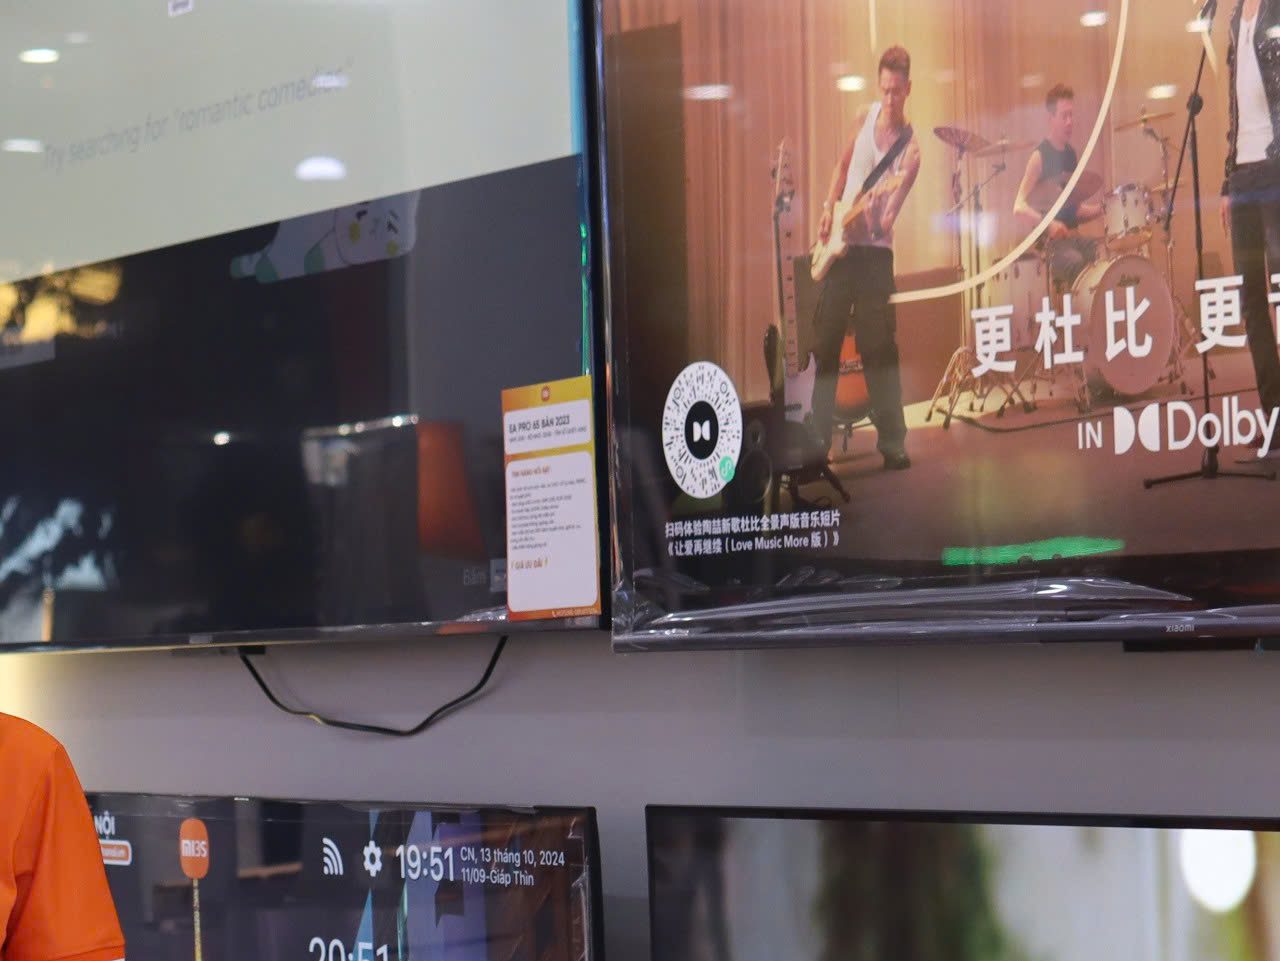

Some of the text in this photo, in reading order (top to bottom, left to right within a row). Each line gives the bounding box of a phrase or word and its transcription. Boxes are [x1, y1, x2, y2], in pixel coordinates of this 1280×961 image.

[69, 125, 141, 164] searching
[144, 112, 168, 143] for
[970, 273, 1280, 378] 更杜比 更
[1077, 395, 1280, 459] IN Dolby
[755, 536, 781, 550] Music
[784, 534, 808, 548] More
[395, 844, 565, 882] 19:51 CN, 13 tháng 10, 2024
